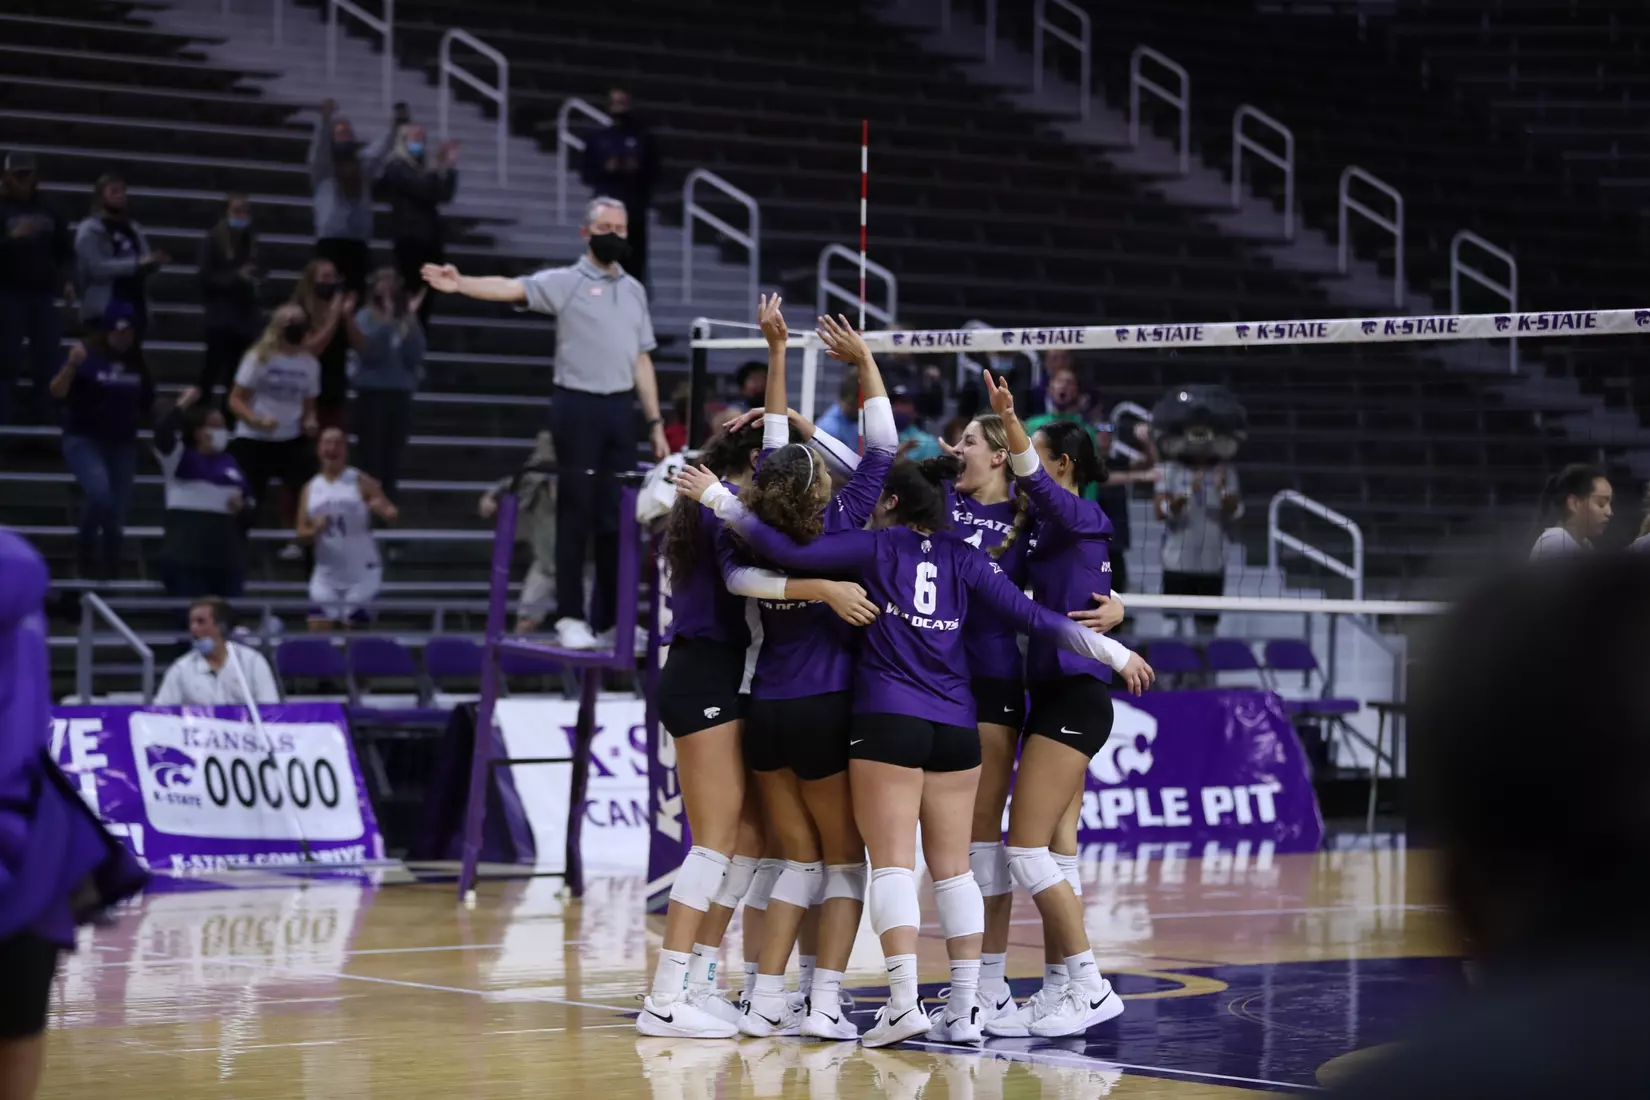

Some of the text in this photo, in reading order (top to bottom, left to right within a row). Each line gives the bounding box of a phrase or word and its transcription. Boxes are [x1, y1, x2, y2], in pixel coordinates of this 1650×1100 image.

[1383, 318, 1460, 335] K-STATE
[1518, 312, 1598, 331] K-STATE
[1020, 330, 1085, 345] K-STATE
[1136, 326, 1203, 342] K-STATE
[1257, 322, 1328, 339] K-STATE
[910, 333, 973, 347] K-STATE
[913, 561, 938, 616] 6
[182, 727, 296, 752] KANSS
[1201, 783, 1282, 826] PIT
